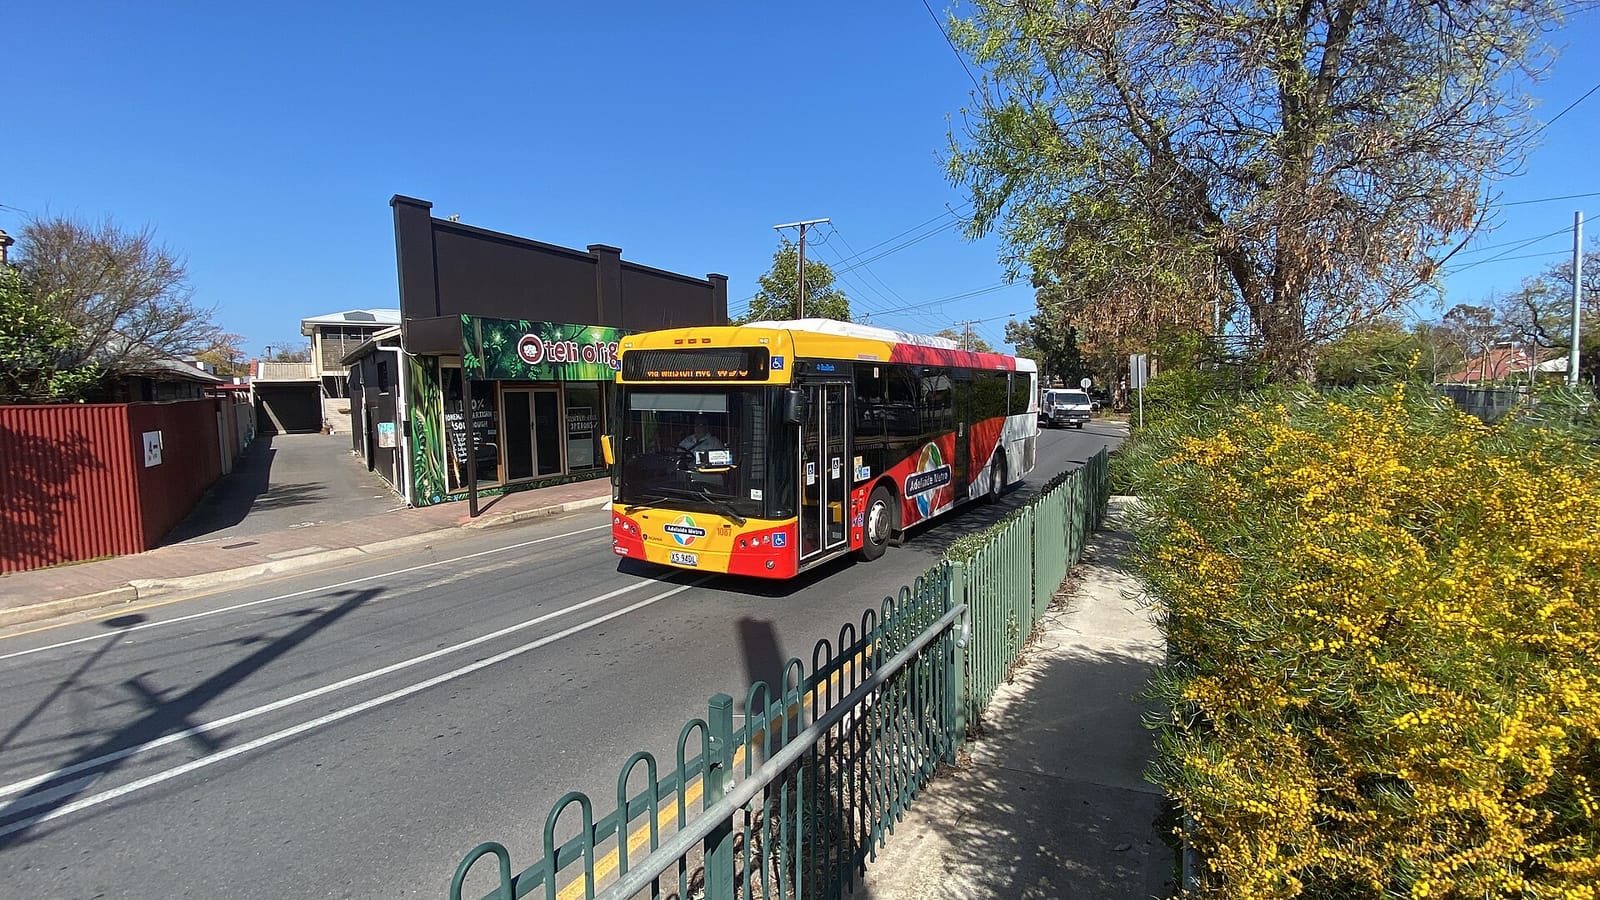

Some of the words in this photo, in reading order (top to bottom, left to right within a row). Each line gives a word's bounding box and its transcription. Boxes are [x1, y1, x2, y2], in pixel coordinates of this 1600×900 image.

[910, 475, 933, 491] Adelaide
[934, 473, 948, 482] Metro
[672, 553, 680, 561] XS
